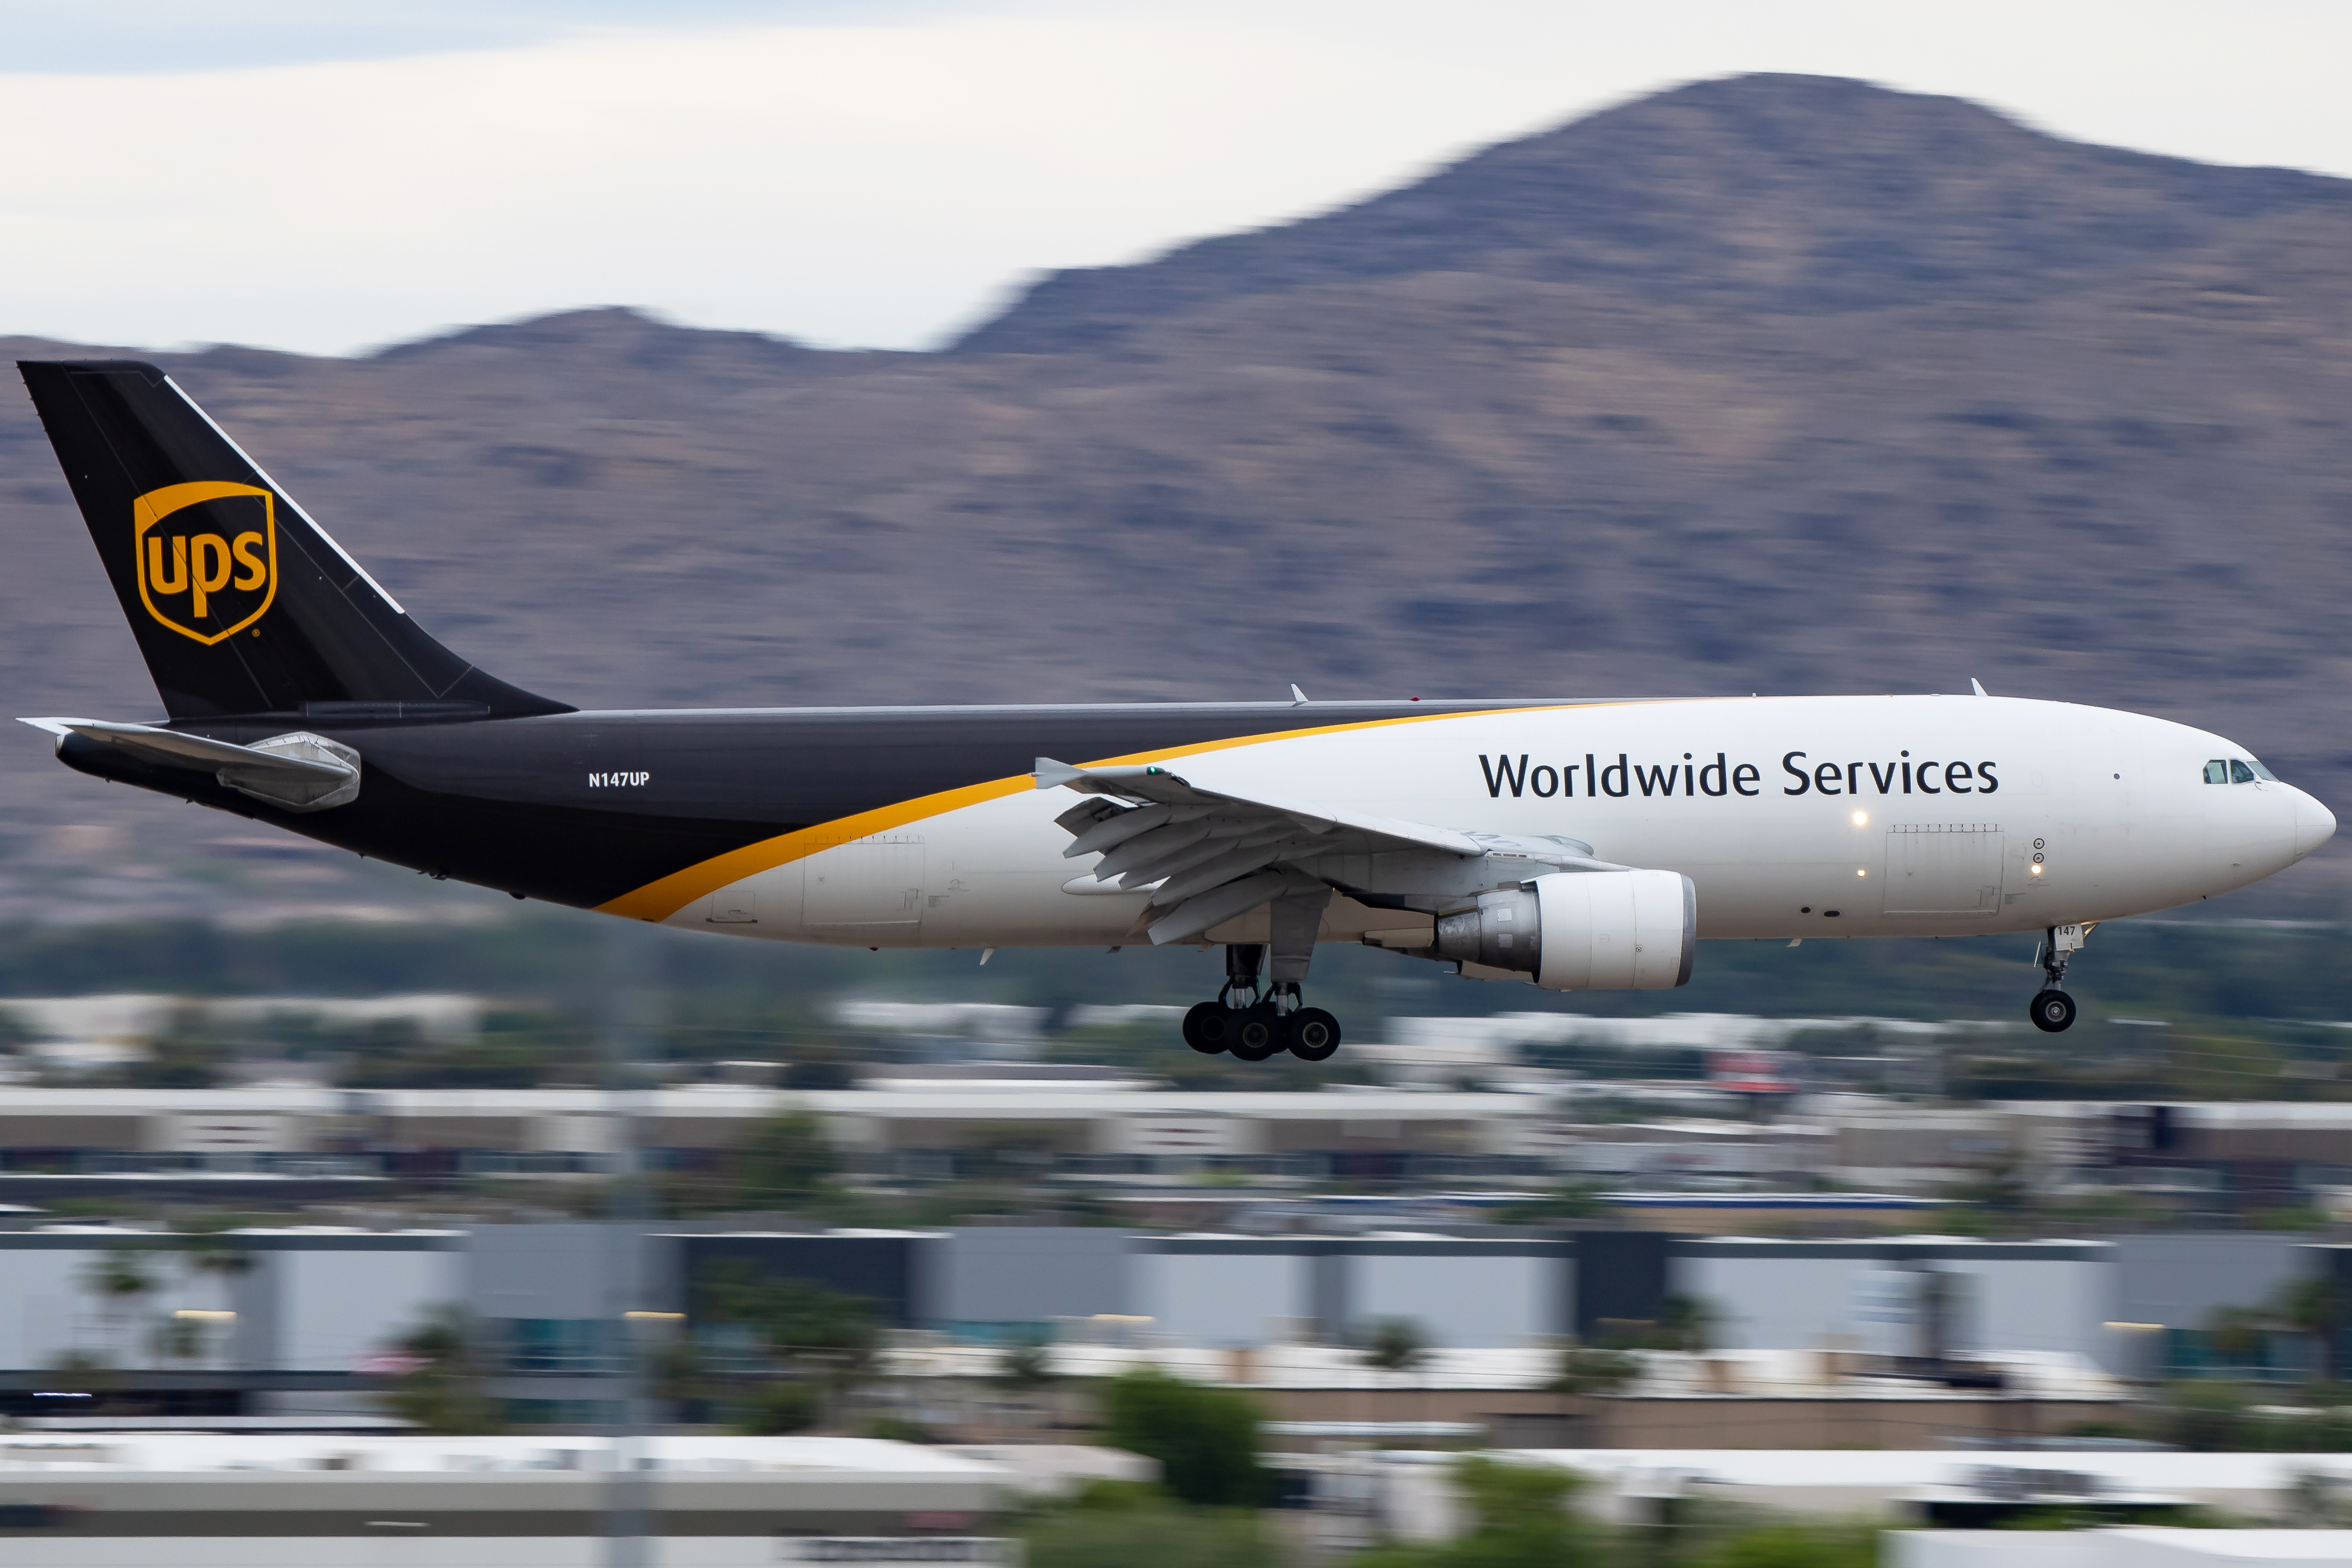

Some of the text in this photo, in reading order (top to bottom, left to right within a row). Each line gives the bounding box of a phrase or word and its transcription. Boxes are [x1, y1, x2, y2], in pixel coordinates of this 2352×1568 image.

[588, 772, 650, 787] N147UP
[1479, 750, 1999, 797] Worldwide Services
[2058, 926, 2076, 936] 147
